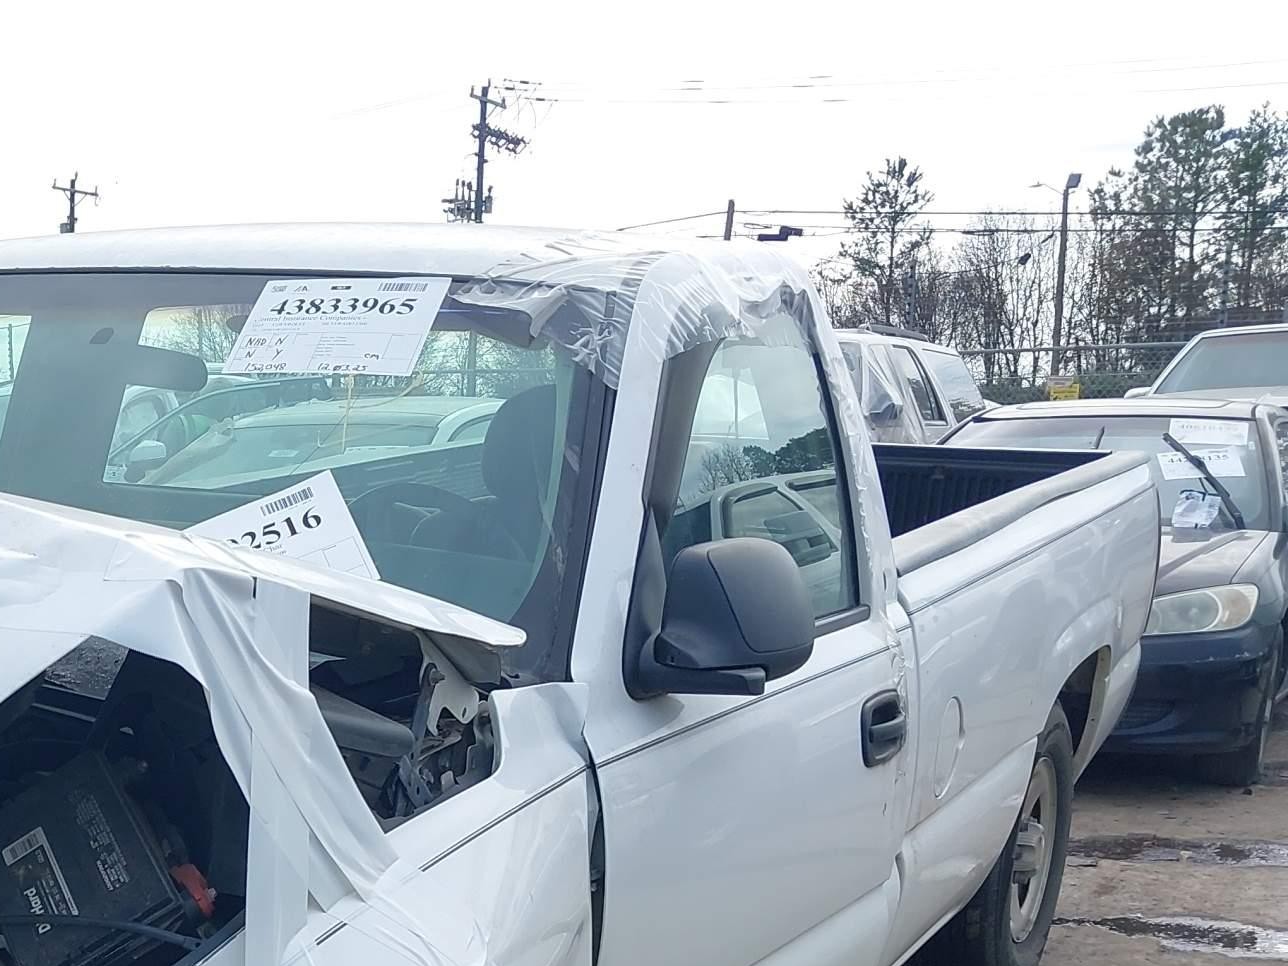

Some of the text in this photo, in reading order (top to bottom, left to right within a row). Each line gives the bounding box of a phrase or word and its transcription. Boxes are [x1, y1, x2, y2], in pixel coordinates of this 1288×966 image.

[270, 297, 418, 315] 43833965
[226, 505, 322, 549] 2516
[24, 887, 51, 935] DHard
